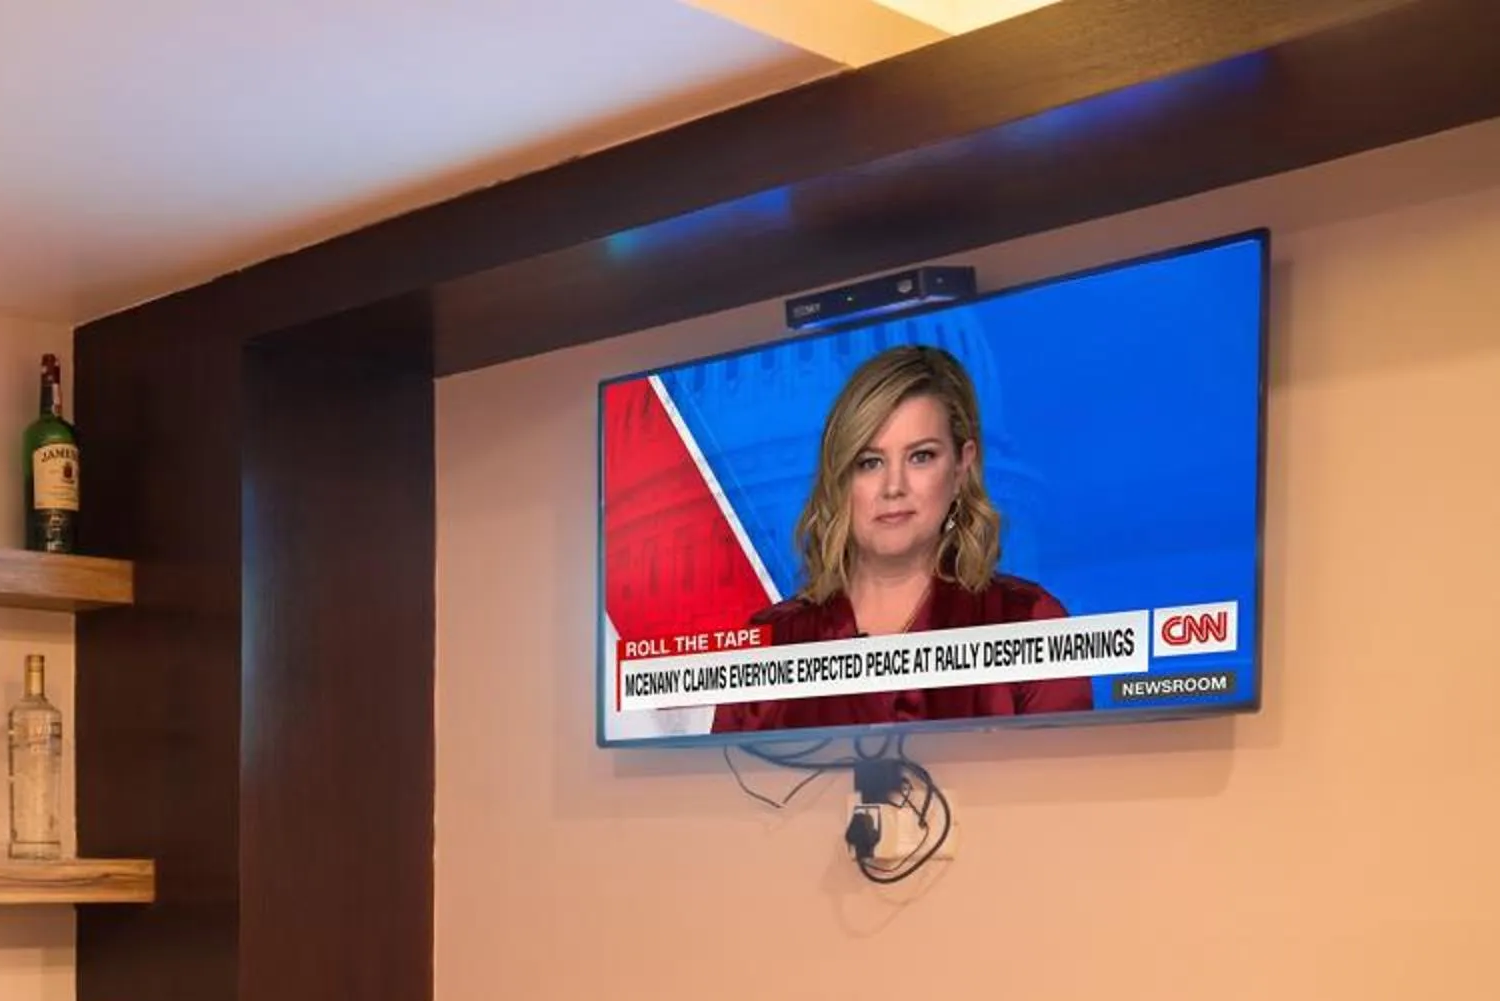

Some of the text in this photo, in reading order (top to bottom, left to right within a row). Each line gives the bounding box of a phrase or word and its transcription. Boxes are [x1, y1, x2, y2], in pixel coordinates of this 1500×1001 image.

[625, 628, 761, 657] ROLL THE TAPE
[1161, 611, 1228, 646] CNN
[625, 627, 1135, 697] MCENANY CLAIMS EVERYONE EXPECTED PEACE AT RALLY DESPITE WARNINGS
[1122, 676, 1228, 695] NEWSROOM
